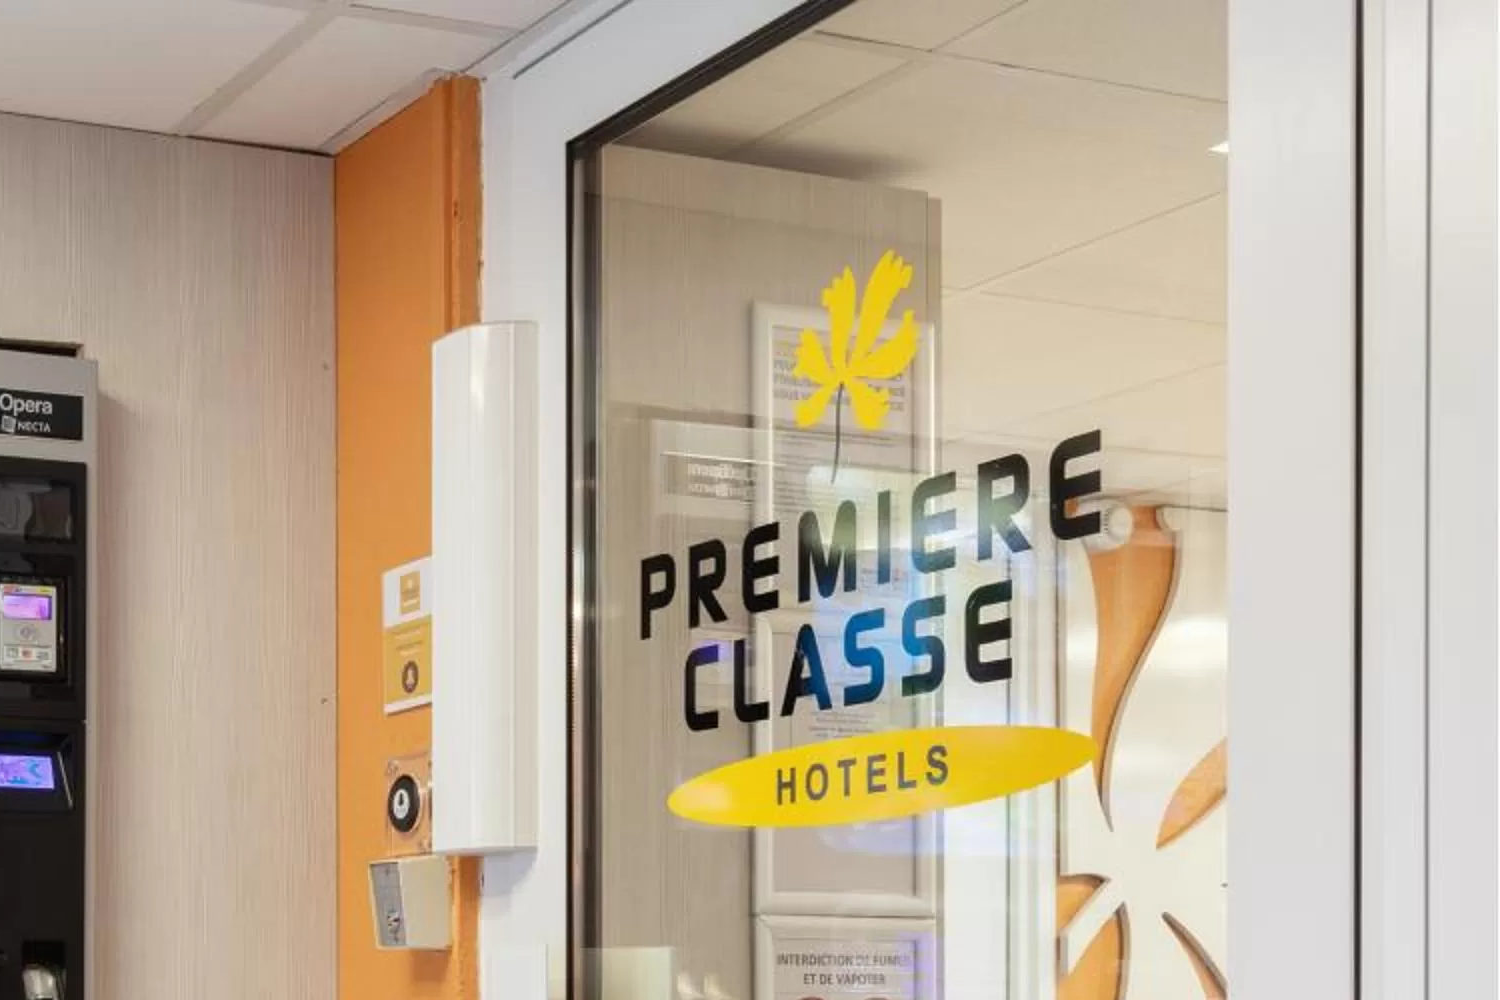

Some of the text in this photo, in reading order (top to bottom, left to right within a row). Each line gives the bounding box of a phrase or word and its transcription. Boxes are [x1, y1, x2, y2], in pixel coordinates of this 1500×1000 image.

[0, 393, 52, 416] Opera
[17, 421, 51, 433] NECTA
[641, 429, 1101, 640] PREMIERE
[684, 579, 1013, 732] CLASSE
[776, 745, 949, 805] HOTELS
[776, 953, 852, 967] INTERDICTION
[857, 954, 870, 967] DE
[803, 973, 886, 985] ET DE VAPOTER
